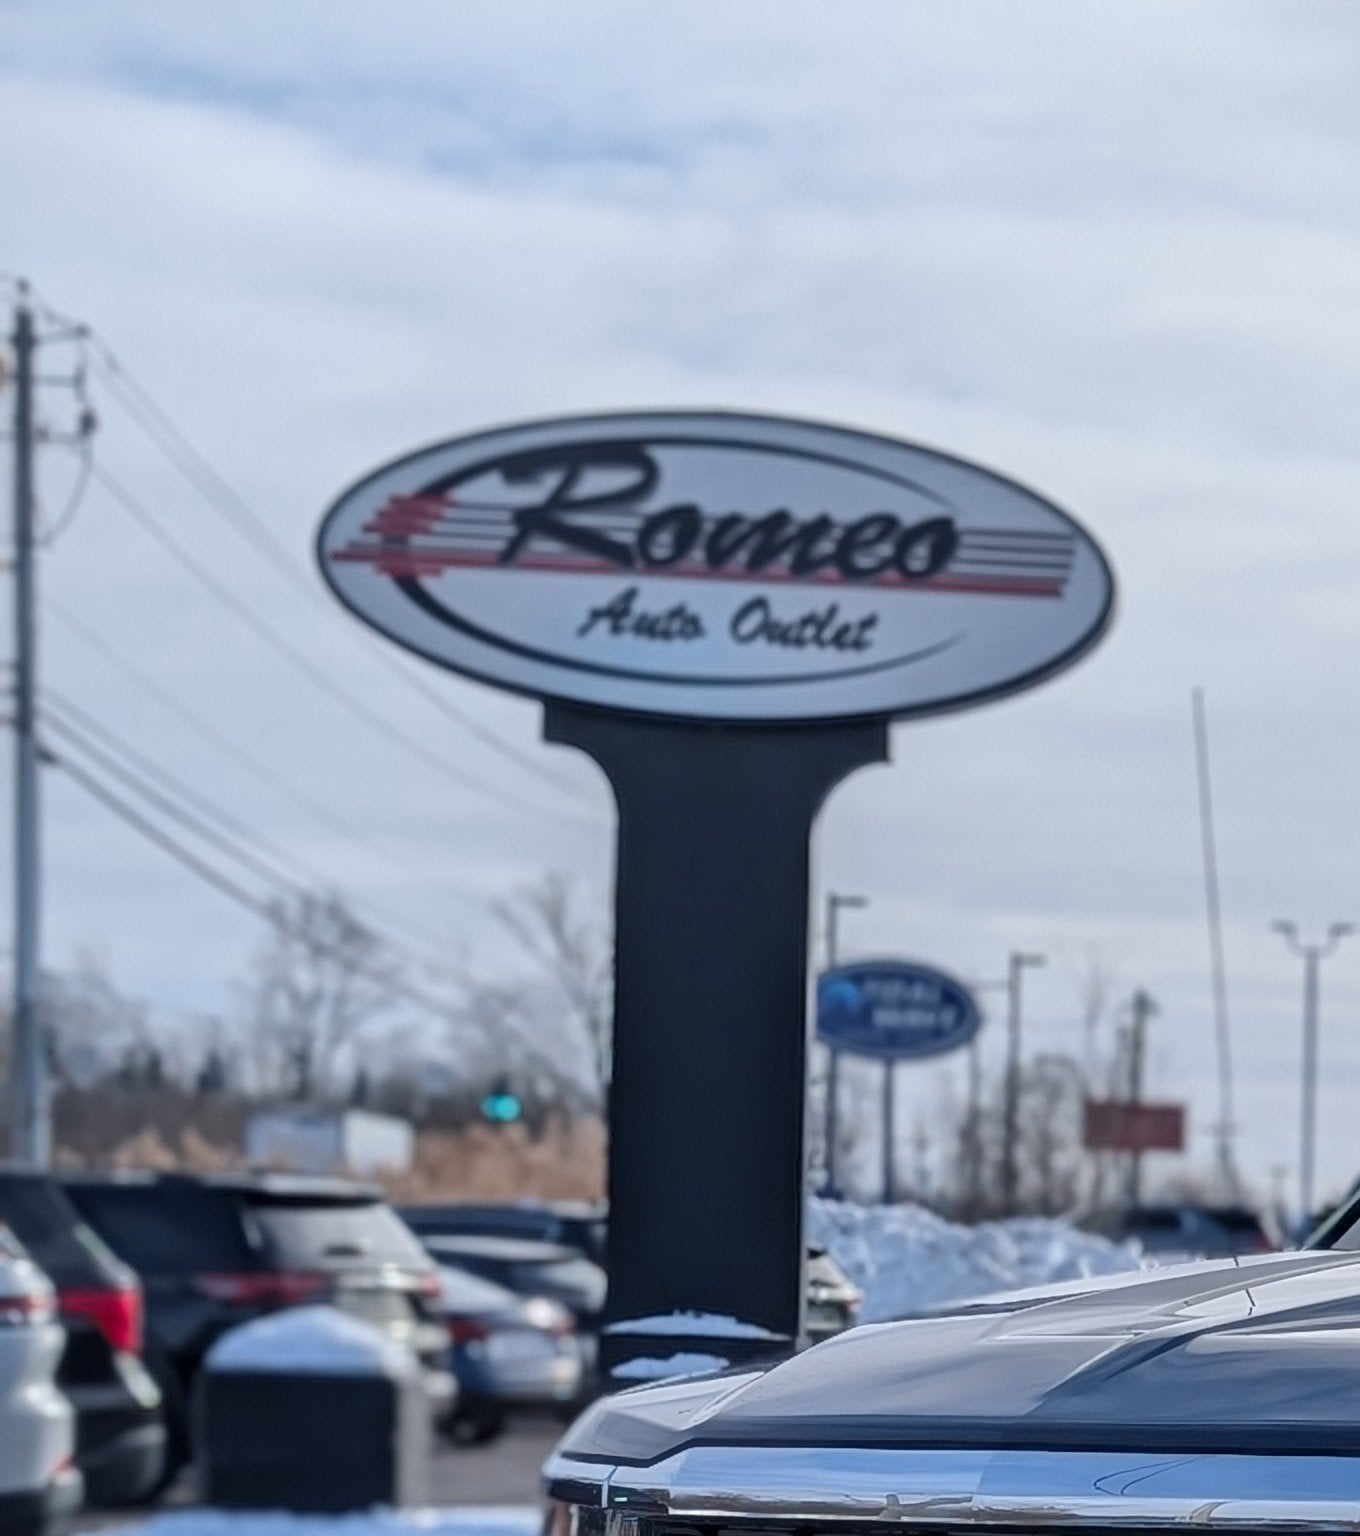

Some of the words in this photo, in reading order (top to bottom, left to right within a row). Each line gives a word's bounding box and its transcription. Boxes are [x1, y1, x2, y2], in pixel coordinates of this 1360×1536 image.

[499, 442, 959, 581] Romeo
[577, 586, 706, 642] Auto
[728, 594, 881, 652] Outlet
